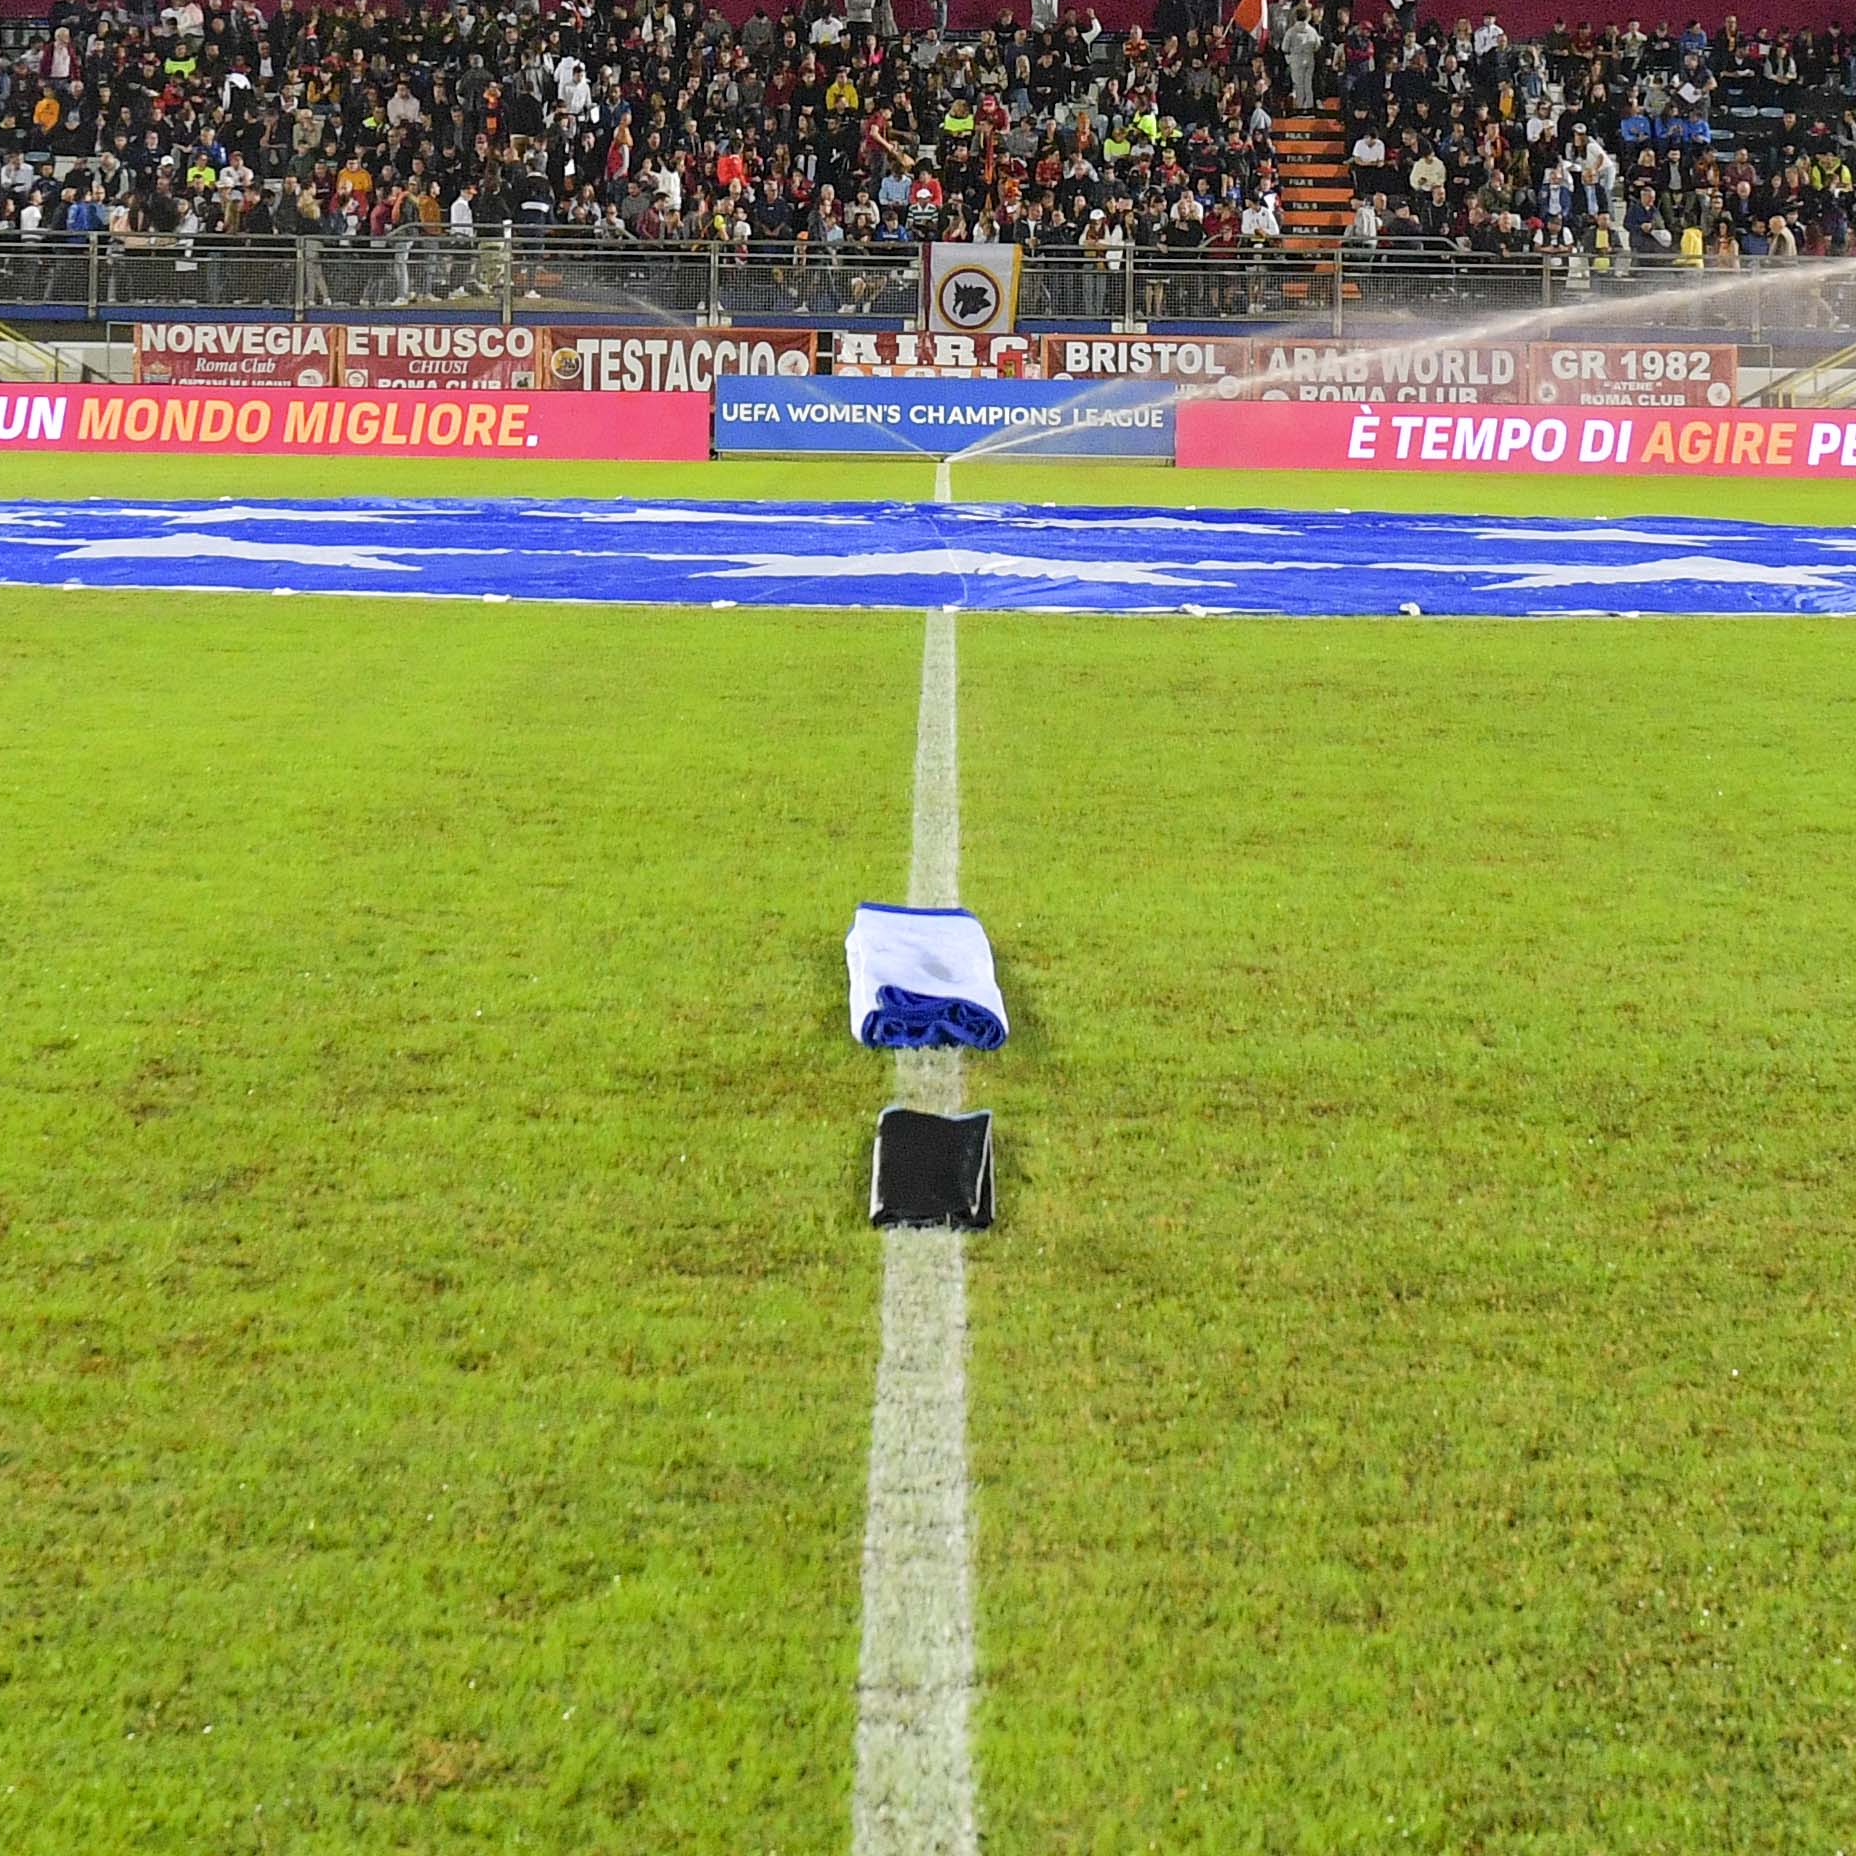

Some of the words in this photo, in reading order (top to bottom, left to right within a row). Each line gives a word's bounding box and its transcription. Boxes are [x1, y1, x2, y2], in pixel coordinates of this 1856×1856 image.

[1285, 132, 1303, 140] FILA
[1287, 154, 1304, 163] FILA
[1289, 178, 1305, 186] FILA
[141, 324, 329, 356] NORVEGIA
[346, 326, 535, 359] ETRUSCO
[194, 357, 238, 373] Roma
[240, 357, 277, 374] Club
[408, 359, 471, 375] CHIUSI
[576, 338, 776, 392] TESTACCIO
[1065, 341, 1226, 375] BRISTOL
[1265, 347, 1370, 383] ARAB
[1380, 348, 1515, 385] WORLD
[1551, 349, 1609, 381] GR
[1619, 350, 1712, 381] 1982
[1298, 385, 1386, 402] ROMA
[1397, 386, 1478, 403] CLUB
[1580, 393, 1633, 406] ROMA
[1637, 394, 1686, 406] CLUB
[77, 398, 271, 443] MONDO
[283, 401, 539, 447] MIGLIORE.
[721, 403, 781, 422] UEFA
[787, 403, 901, 424] WOMEN'S
[909, 404, 1062, 427] CHAMPIONS
[1073, 408, 1164, 429] LEAGUE
[1347, 404, 1381, 459] È
[1391, 416, 1568, 463] TEMPO
[1578, 419, 1633, 463] DI
[1640, 420, 1798, 465] AGIRE
